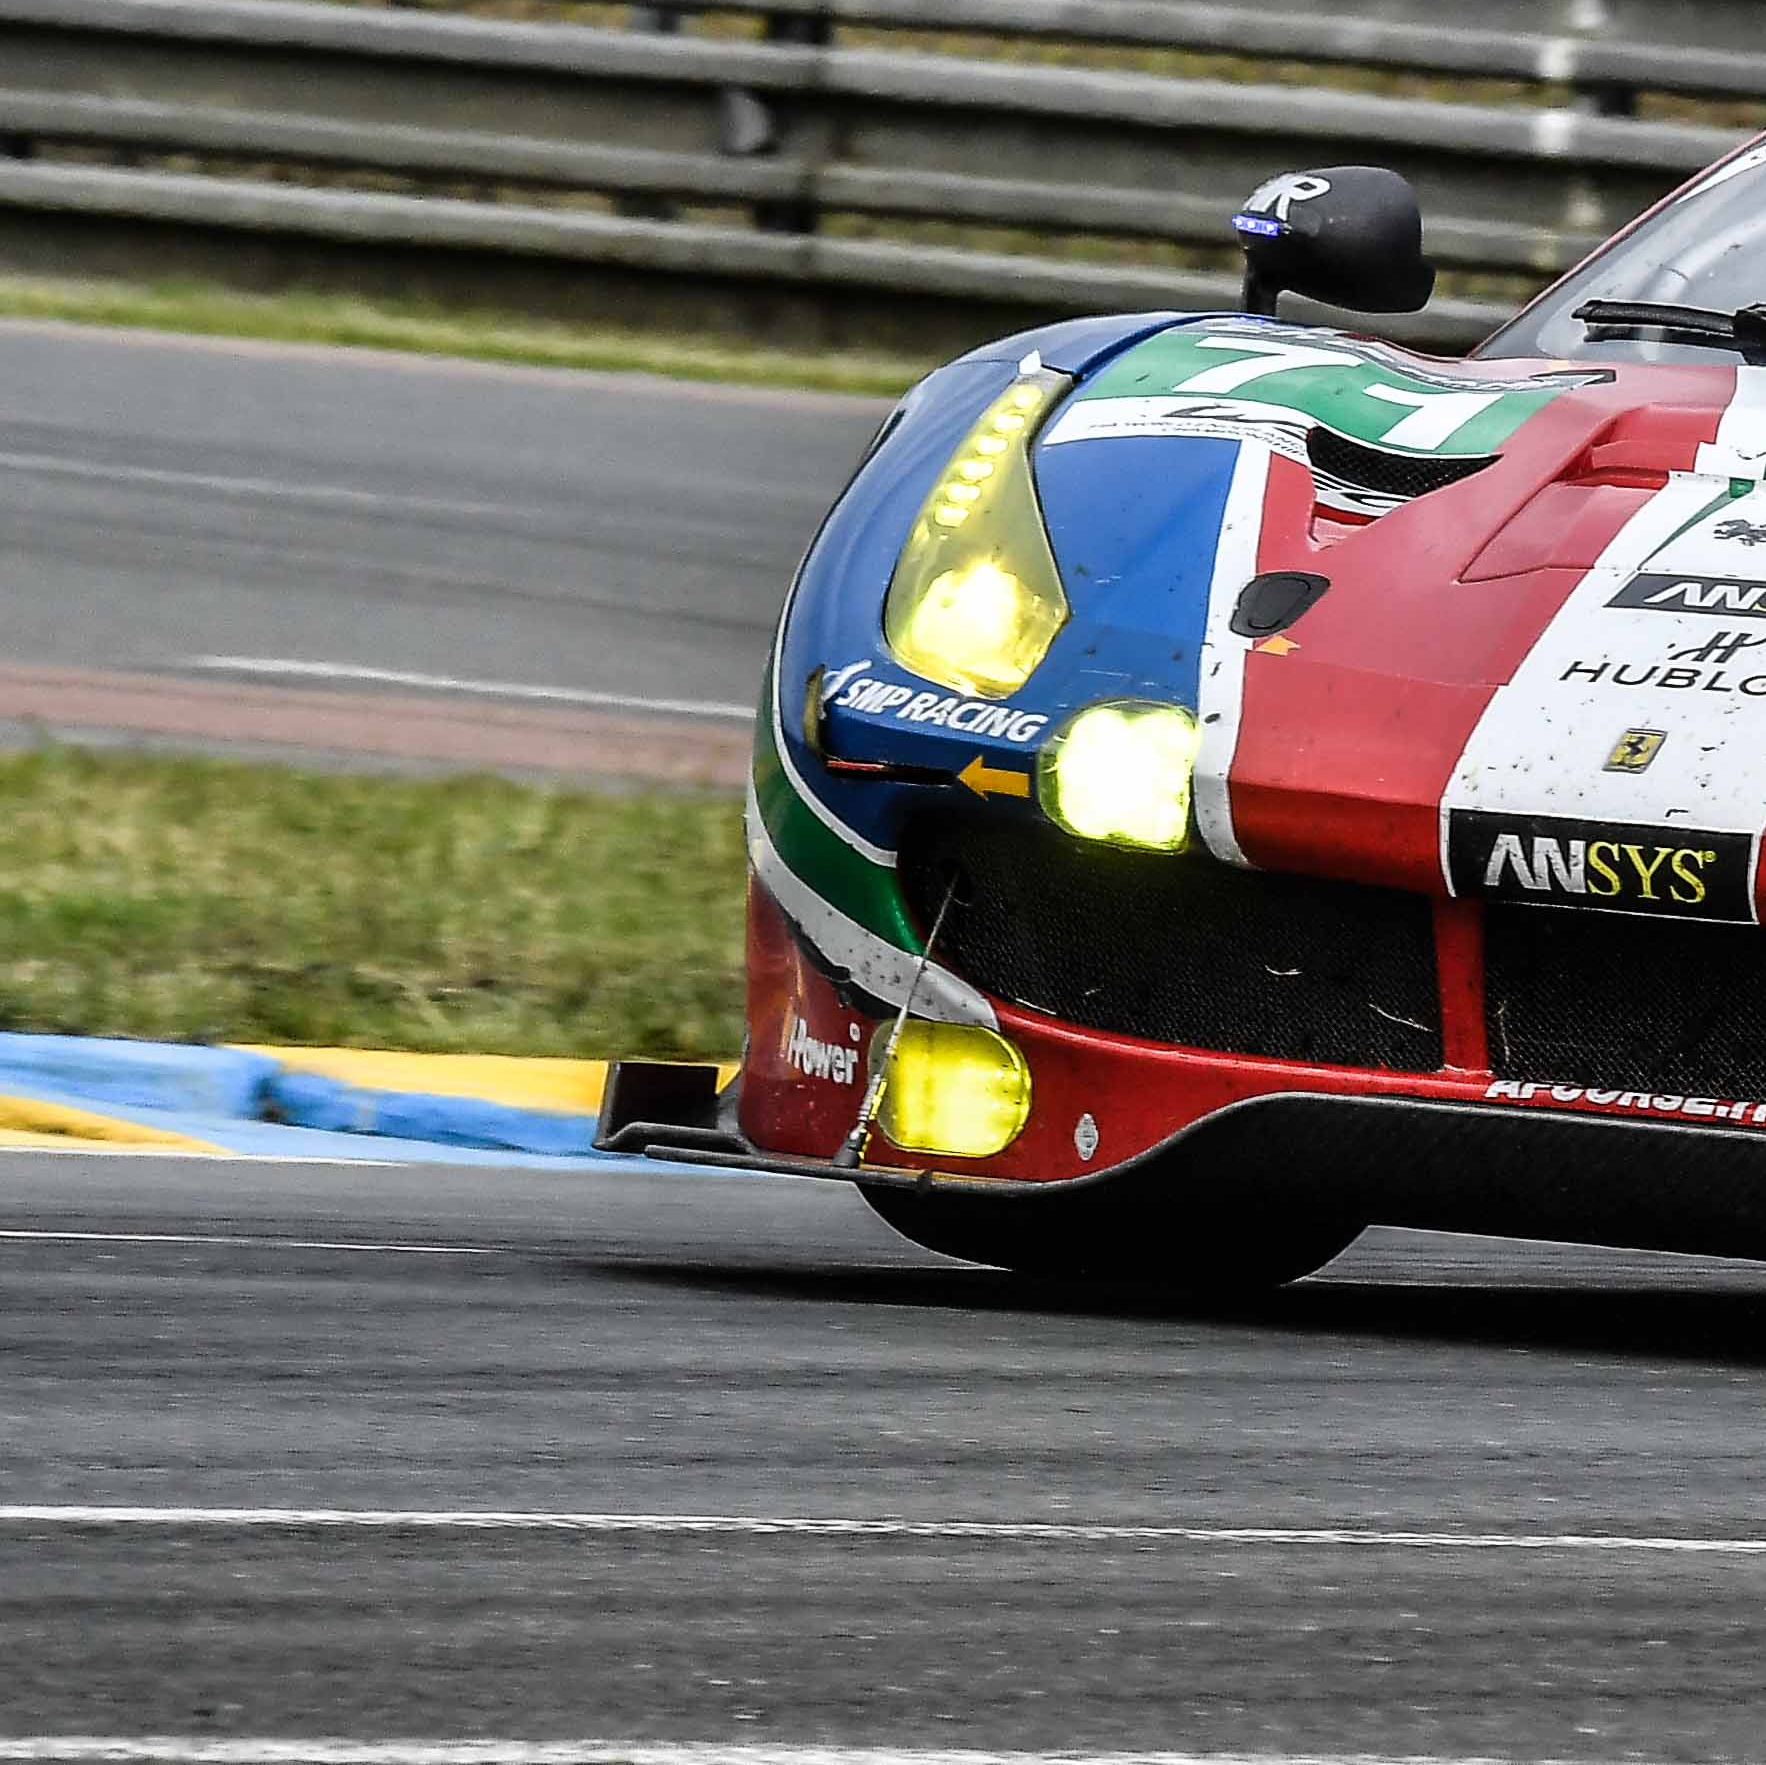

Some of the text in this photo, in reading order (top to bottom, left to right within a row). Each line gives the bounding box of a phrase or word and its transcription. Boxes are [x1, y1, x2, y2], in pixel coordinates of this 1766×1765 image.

[1173, 336, 1506, 451] 71
[834, 676, 1049, 743] SMP RACING
